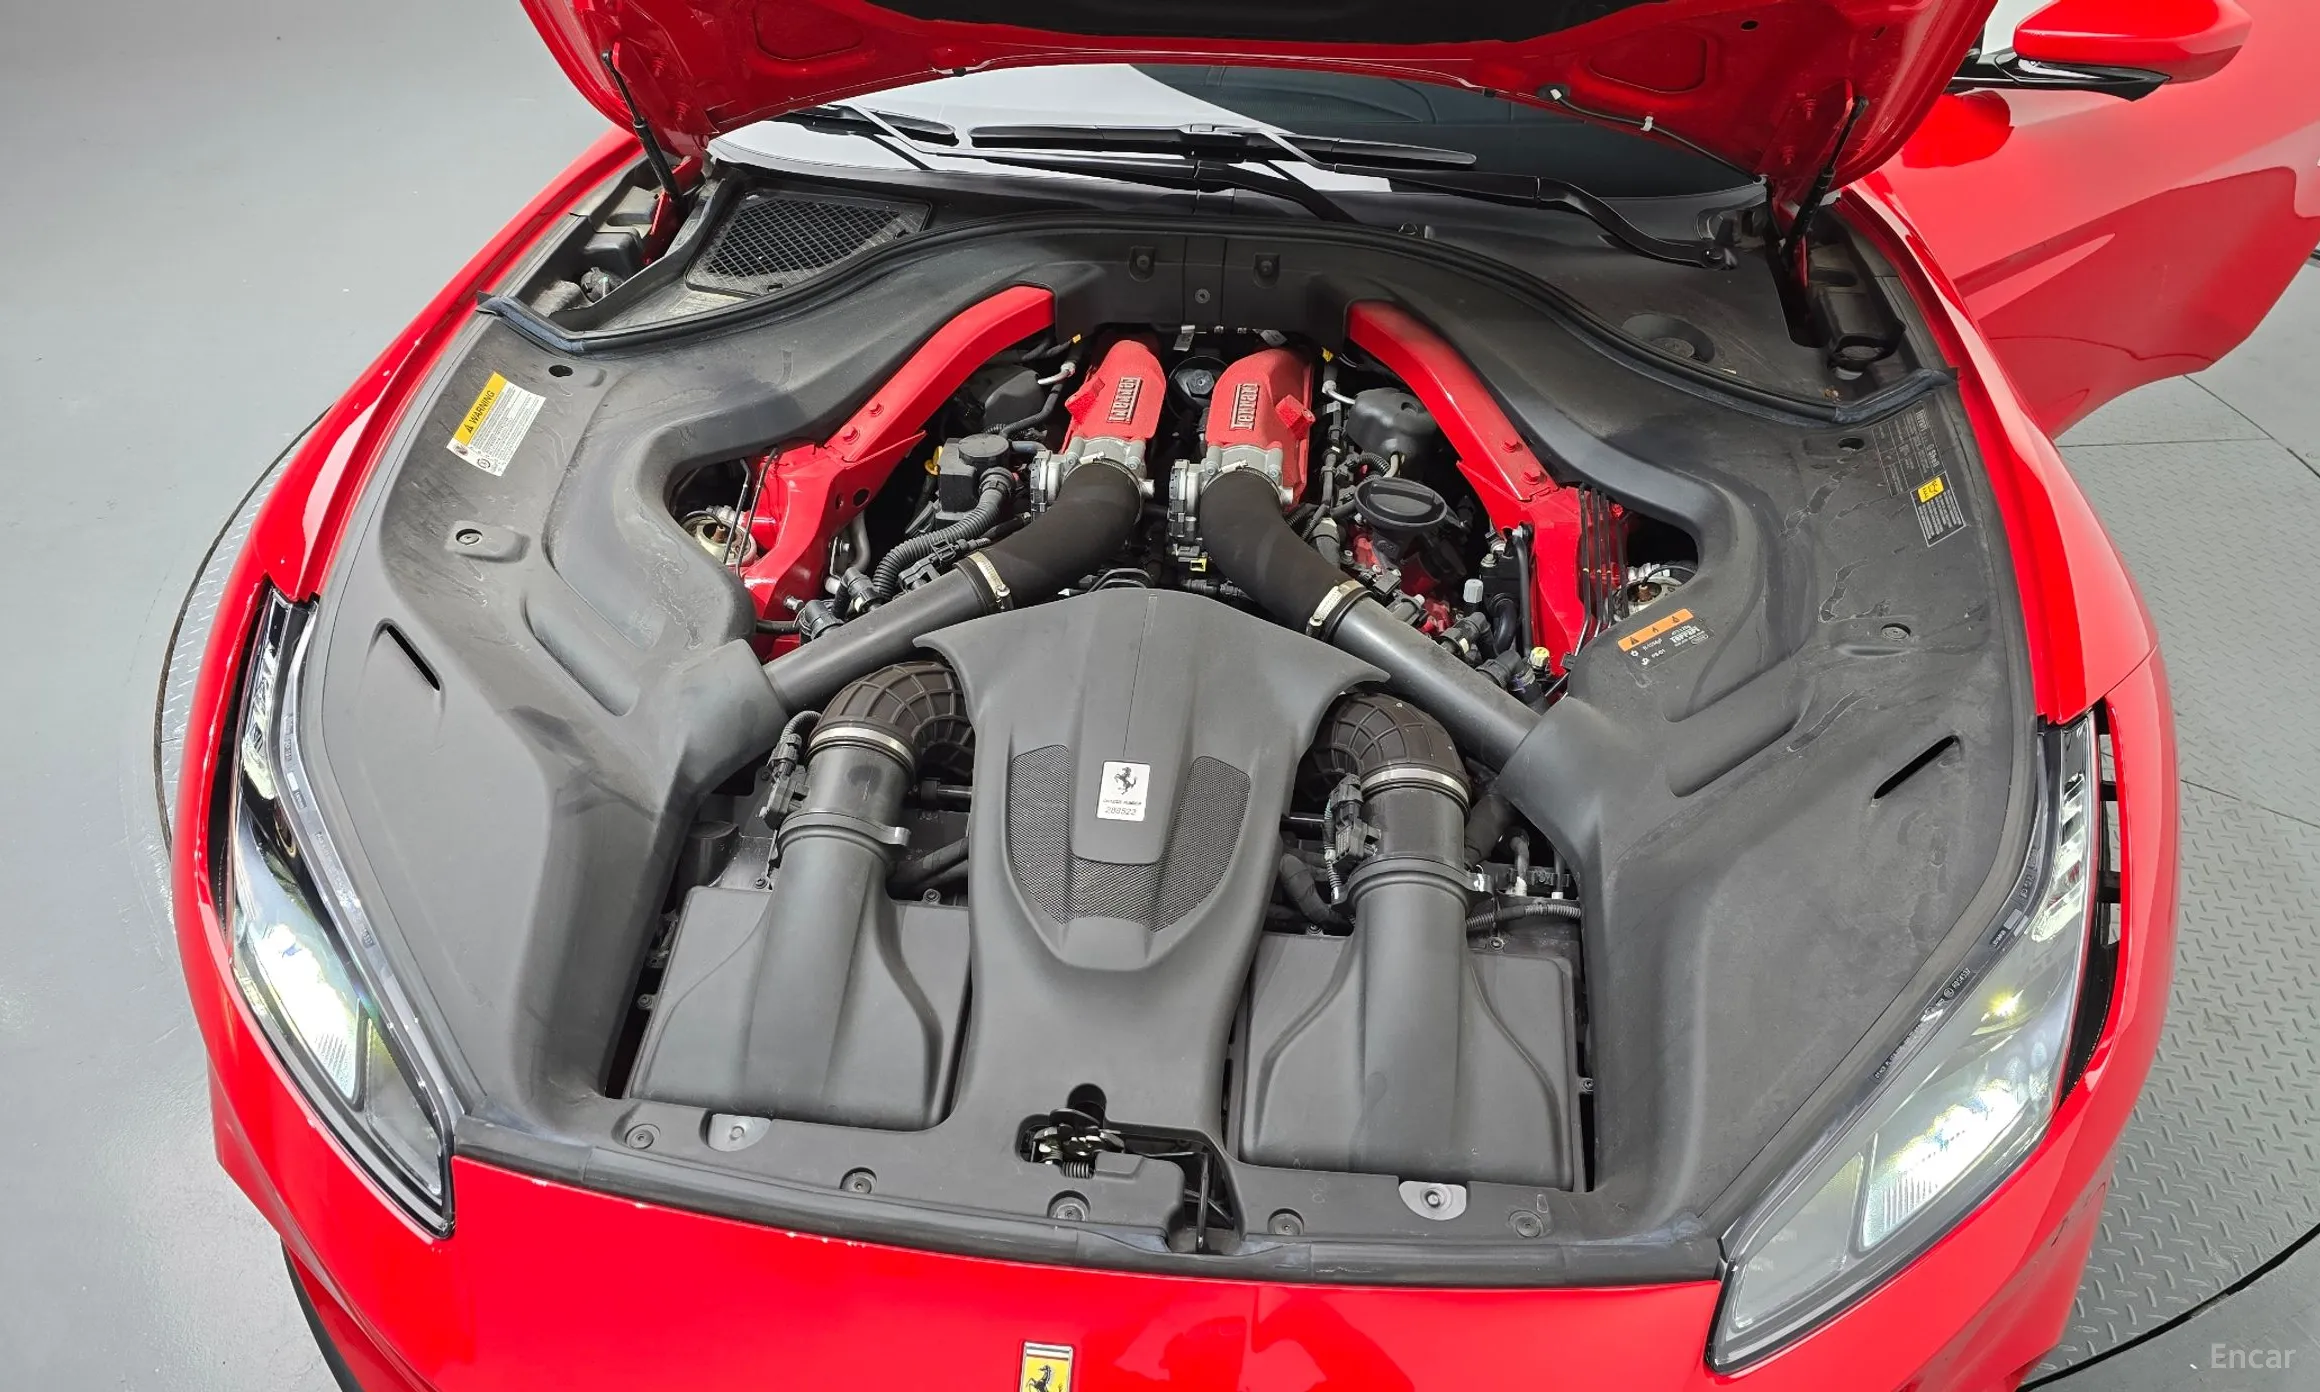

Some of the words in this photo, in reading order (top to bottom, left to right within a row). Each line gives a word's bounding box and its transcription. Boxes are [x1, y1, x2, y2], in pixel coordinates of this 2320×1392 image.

[469, 390, 495, 424] WARNING
[1108, 376, 1142, 423] Ferrari
[1229, 383, 1260, 430] Ferrari
